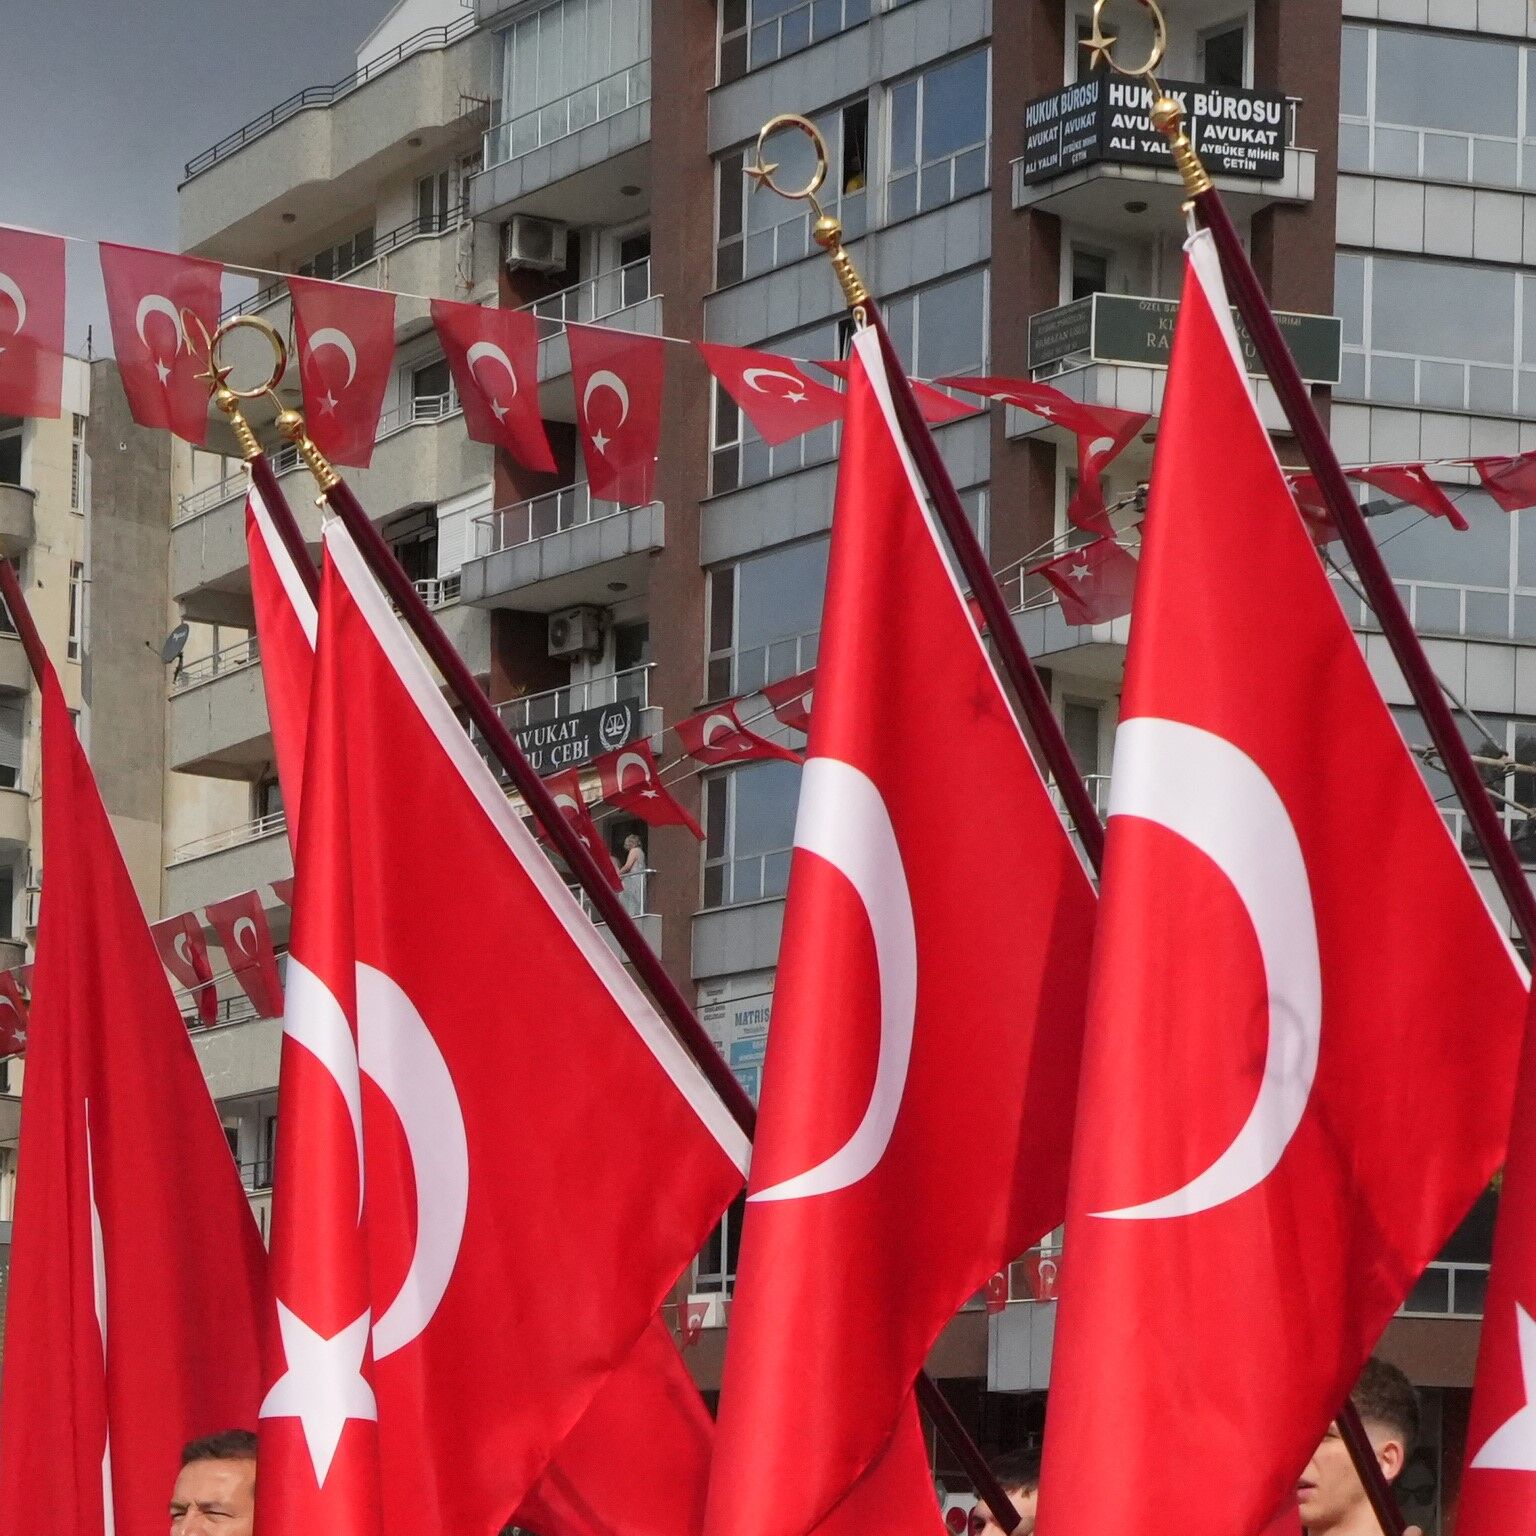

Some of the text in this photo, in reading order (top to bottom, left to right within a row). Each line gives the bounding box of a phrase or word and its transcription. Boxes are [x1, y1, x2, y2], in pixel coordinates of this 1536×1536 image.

[1026, 80, 1099, 128] HUKUK BÜROSU
[1194, 90, 1281, 124] BÜROSU
[1064, 111, 1096, 135] AVUKAT
[1111, 113, 1187, 134] AVUT
[1027, 126, 1058, 150] AVUKAT
[1109, 135, 1171, 154] ALİ YAL
[1204, 124, 1278, 145] AVUKAT
[1200, 143, 1280, 161] AYBÜKE MİHİR
[1223, 157, 1257, 170] ÇETİN
[551, 735, 590, 768] ÇEBİ
